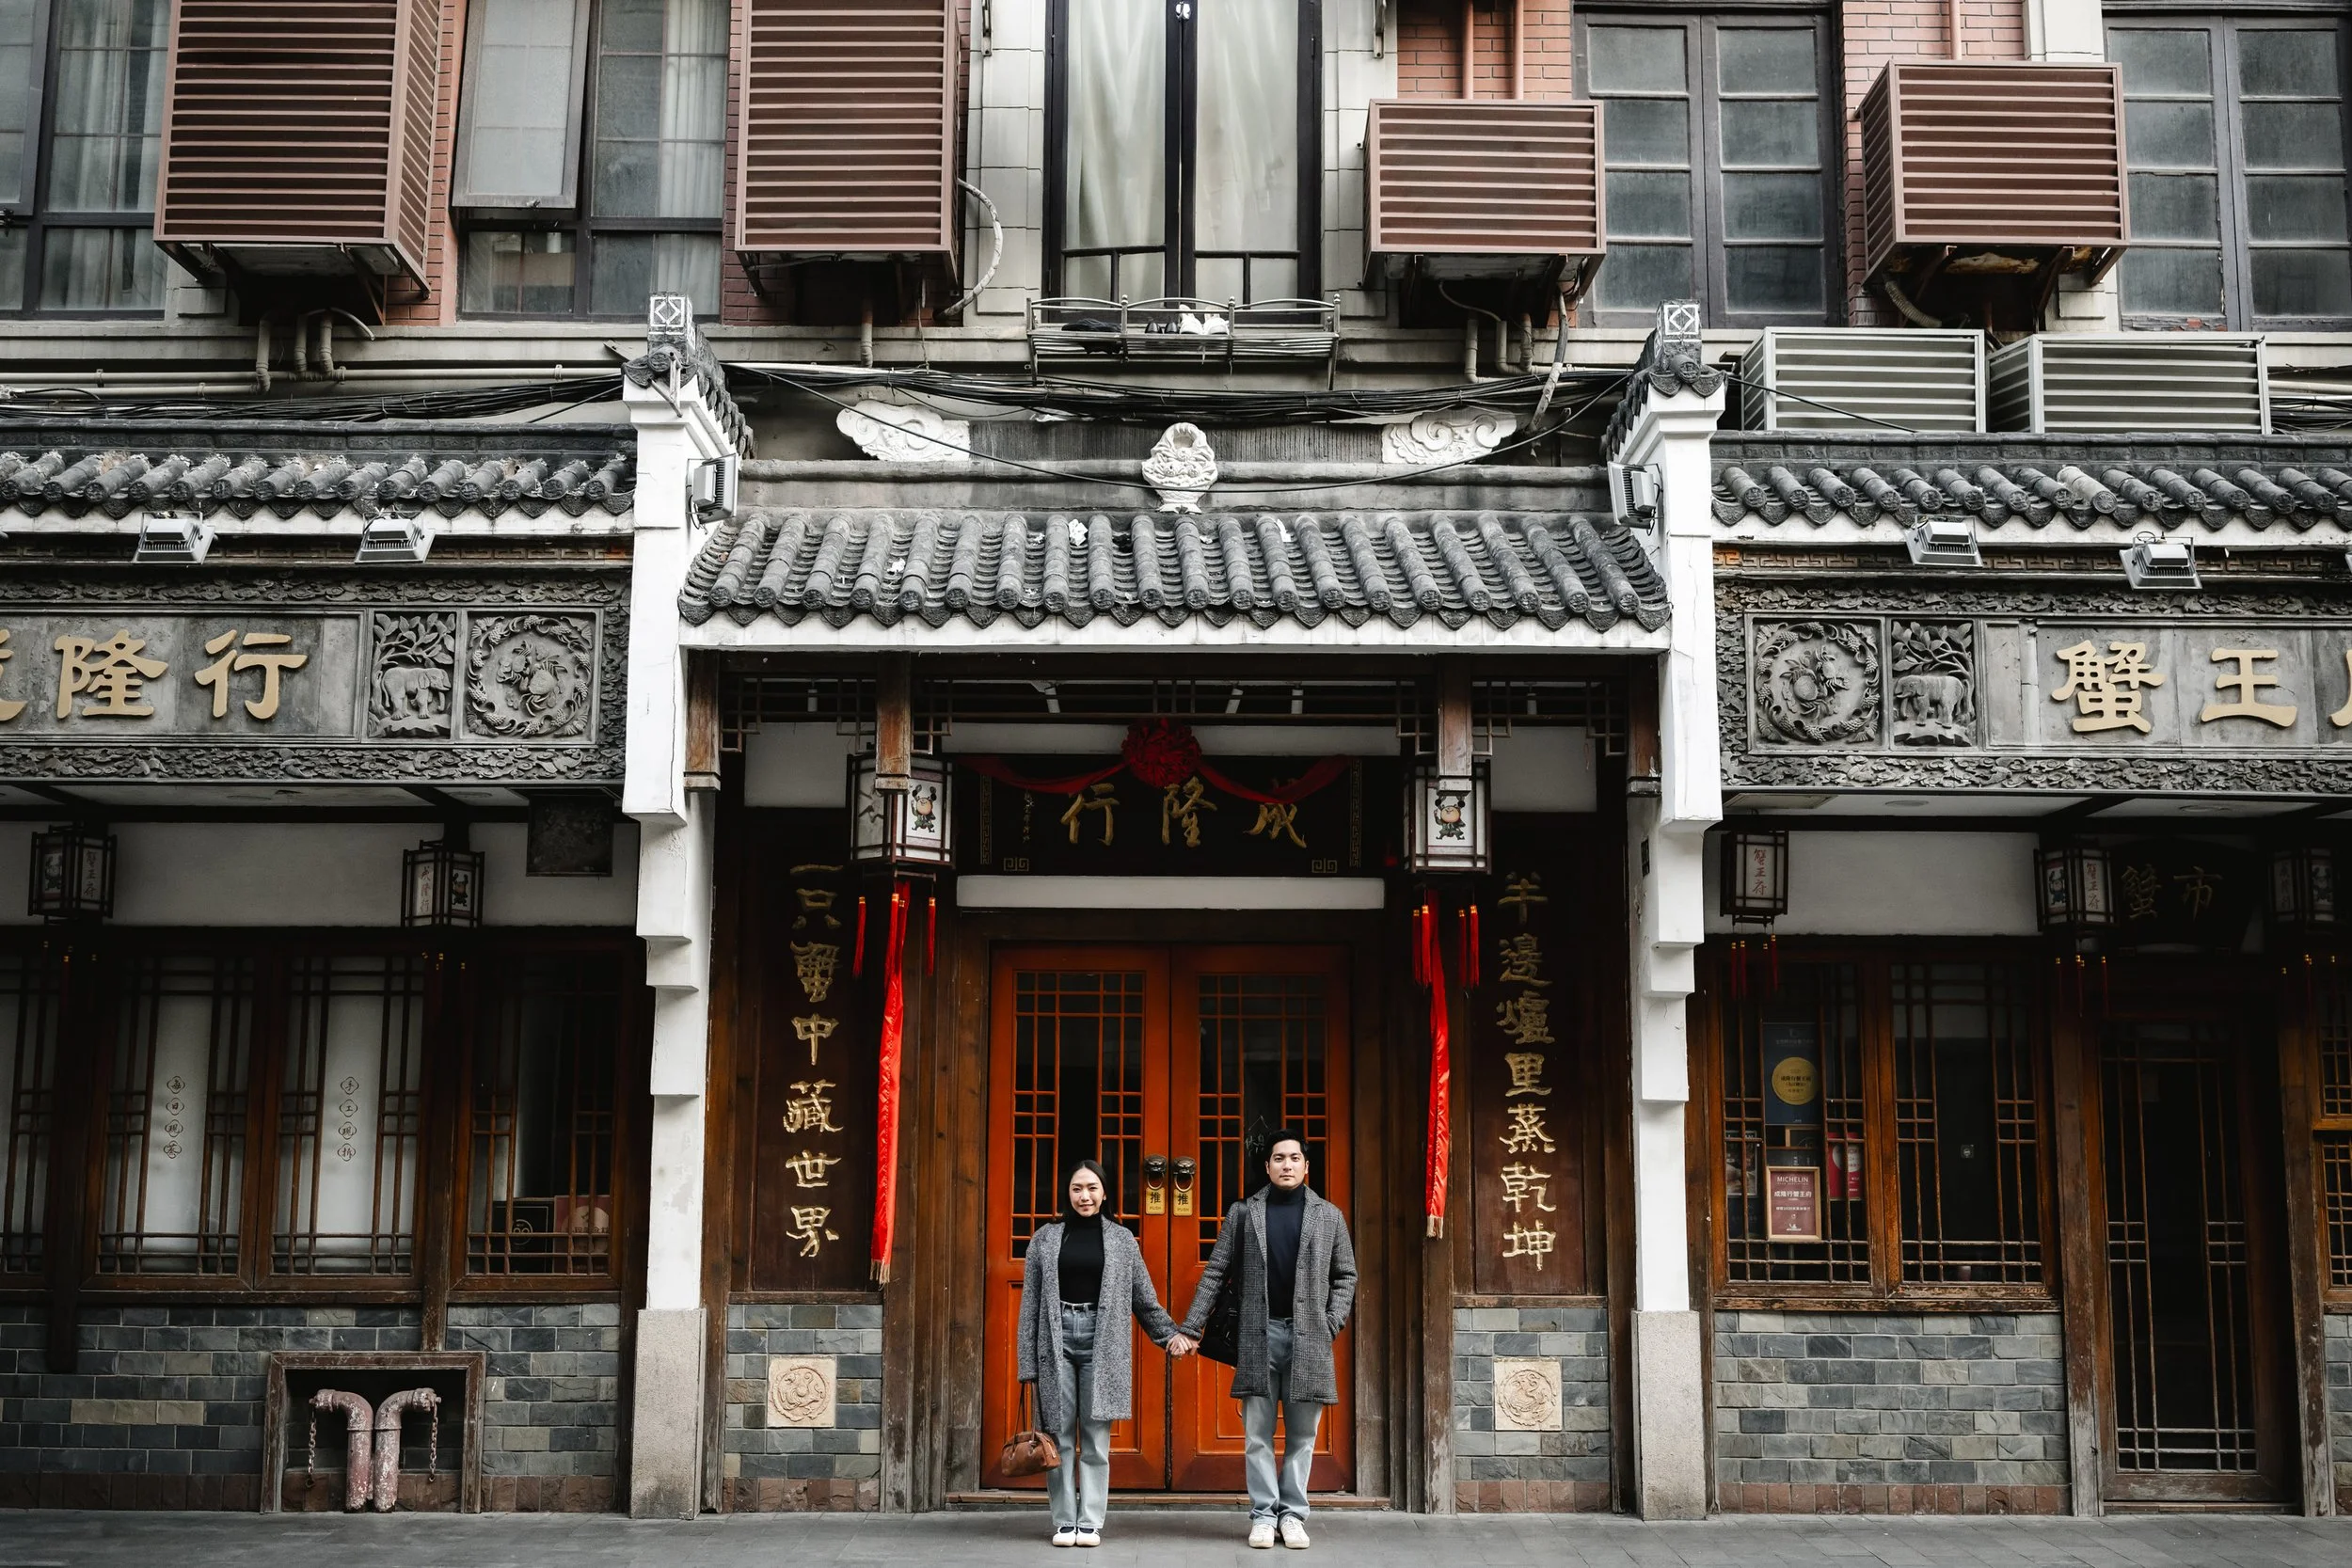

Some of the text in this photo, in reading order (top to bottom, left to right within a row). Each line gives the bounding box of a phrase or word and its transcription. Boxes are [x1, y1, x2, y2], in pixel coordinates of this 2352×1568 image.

[2051, 640, 2352, 733] 蟹王
[1752, 847, 1768, 895] 蟹王府
[2121, 863, 2222, 922] 蟹市
[1150, 1191, 1161, 1204] 推
[1176, 1193, 1189, 1205] 推
